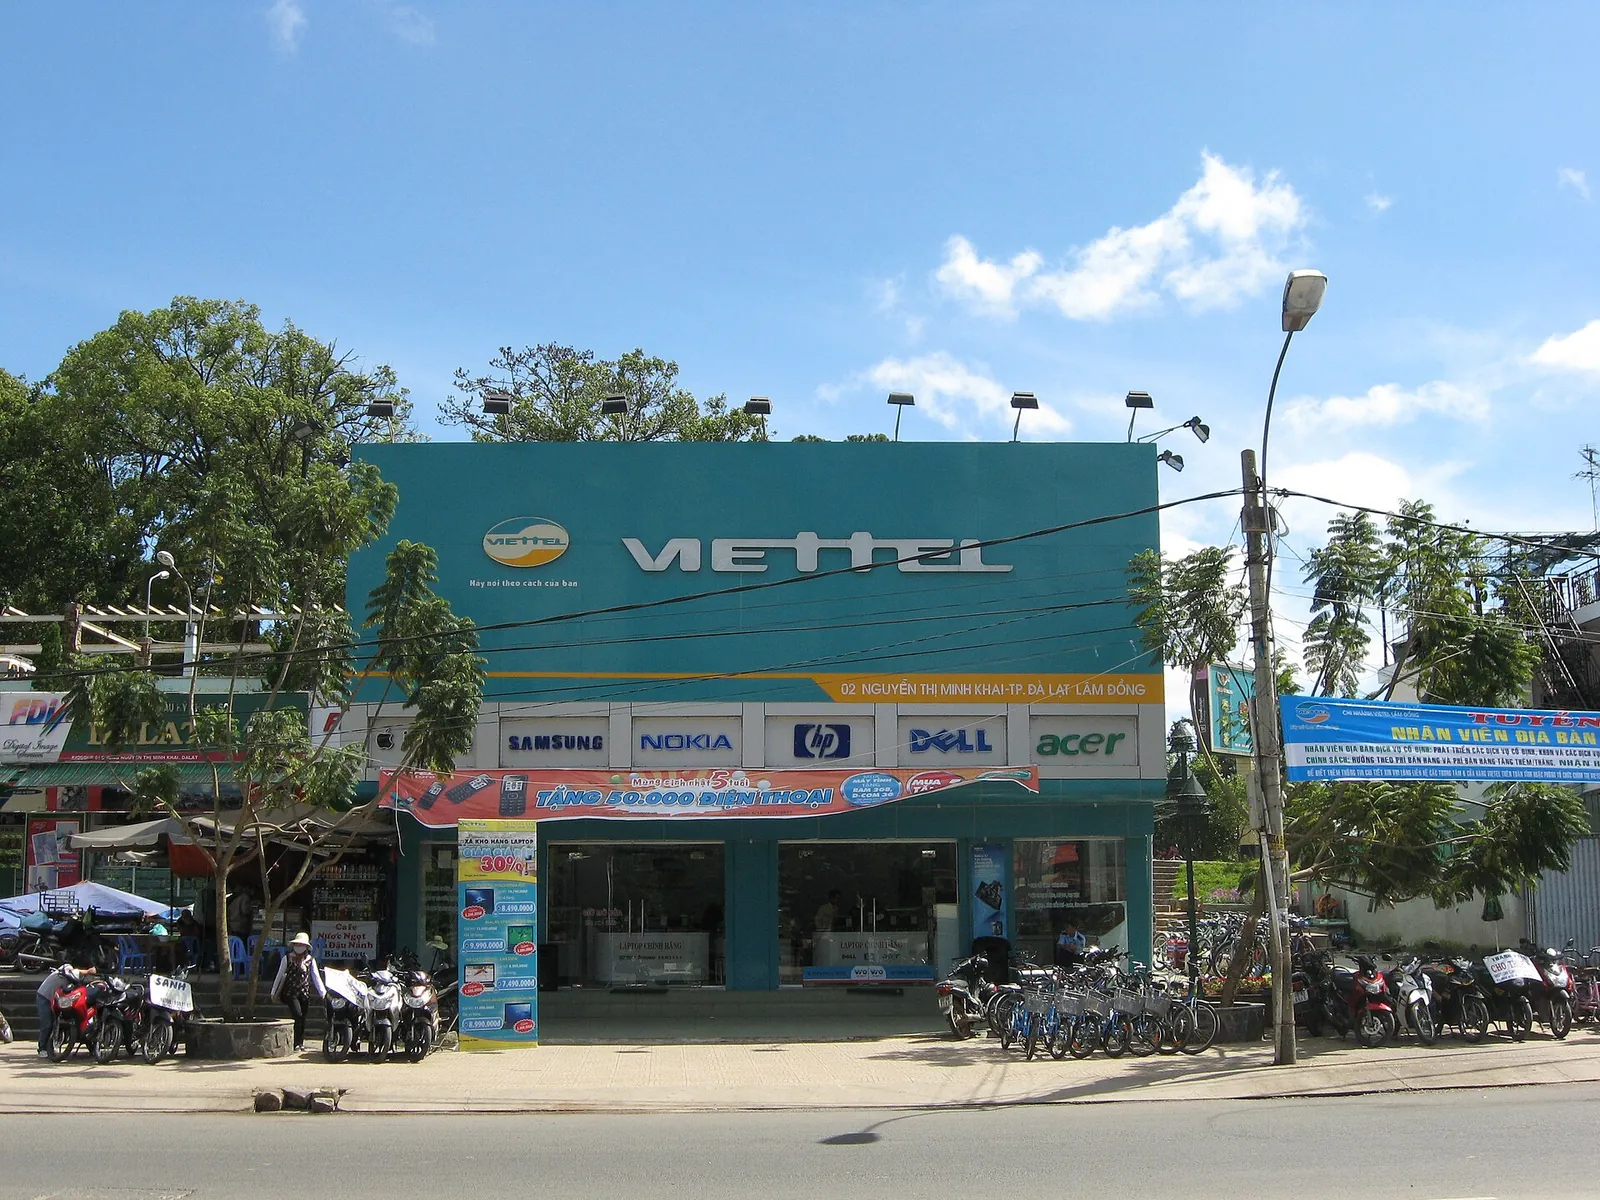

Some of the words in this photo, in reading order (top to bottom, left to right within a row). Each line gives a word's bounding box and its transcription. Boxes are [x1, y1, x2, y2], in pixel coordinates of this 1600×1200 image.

[486, 536, 567, 546] VIETTEL
[621, 531, 1014, 573] VIETTEL
[840, 683, 856, 695] 02
[861, 678, 917, 696] NGUYỄN
[920, 683, 938, 698] THỊ
[940, 683, 972, 695] MINH
[1027, 680, 1046, 696] ĐÀ
[1075, 681, 1104, 696] LÂM
[1107, 678, 1147, 696] ĐỒNG
[508, 734, 604, 750] SAMSUNG
[640, 733, 733, 750] NOKIA
[909, 728, 993, 754] DELL
[1036, 731, 1127, 756] acer
[1391, 725, 1452, 742] NHÂN
[1458, 726, 1508, 742] VIÊN
[1515, 729, 1551, 745] ĐỊA
[1556, 729, 1598, 745] BÀN
[712, 770, 730, 790] 5
[911, 778, 942, 786] MUA
[535, 784, 601, 811] TẶNG
[606, 790, 696, 806] 50.000
[698, 788, 757, 810] ĐIỆN
[760, 787, 834, 809] THOẠI
[481, 855, 523, 873] 30%
[335, 923, 357, 931] Cafe
[469, 941, 503, 949] 9.990.000đ
[324, 950, 340, 958] Bia
[502, 979, 535, 988] 7.490.000đ
